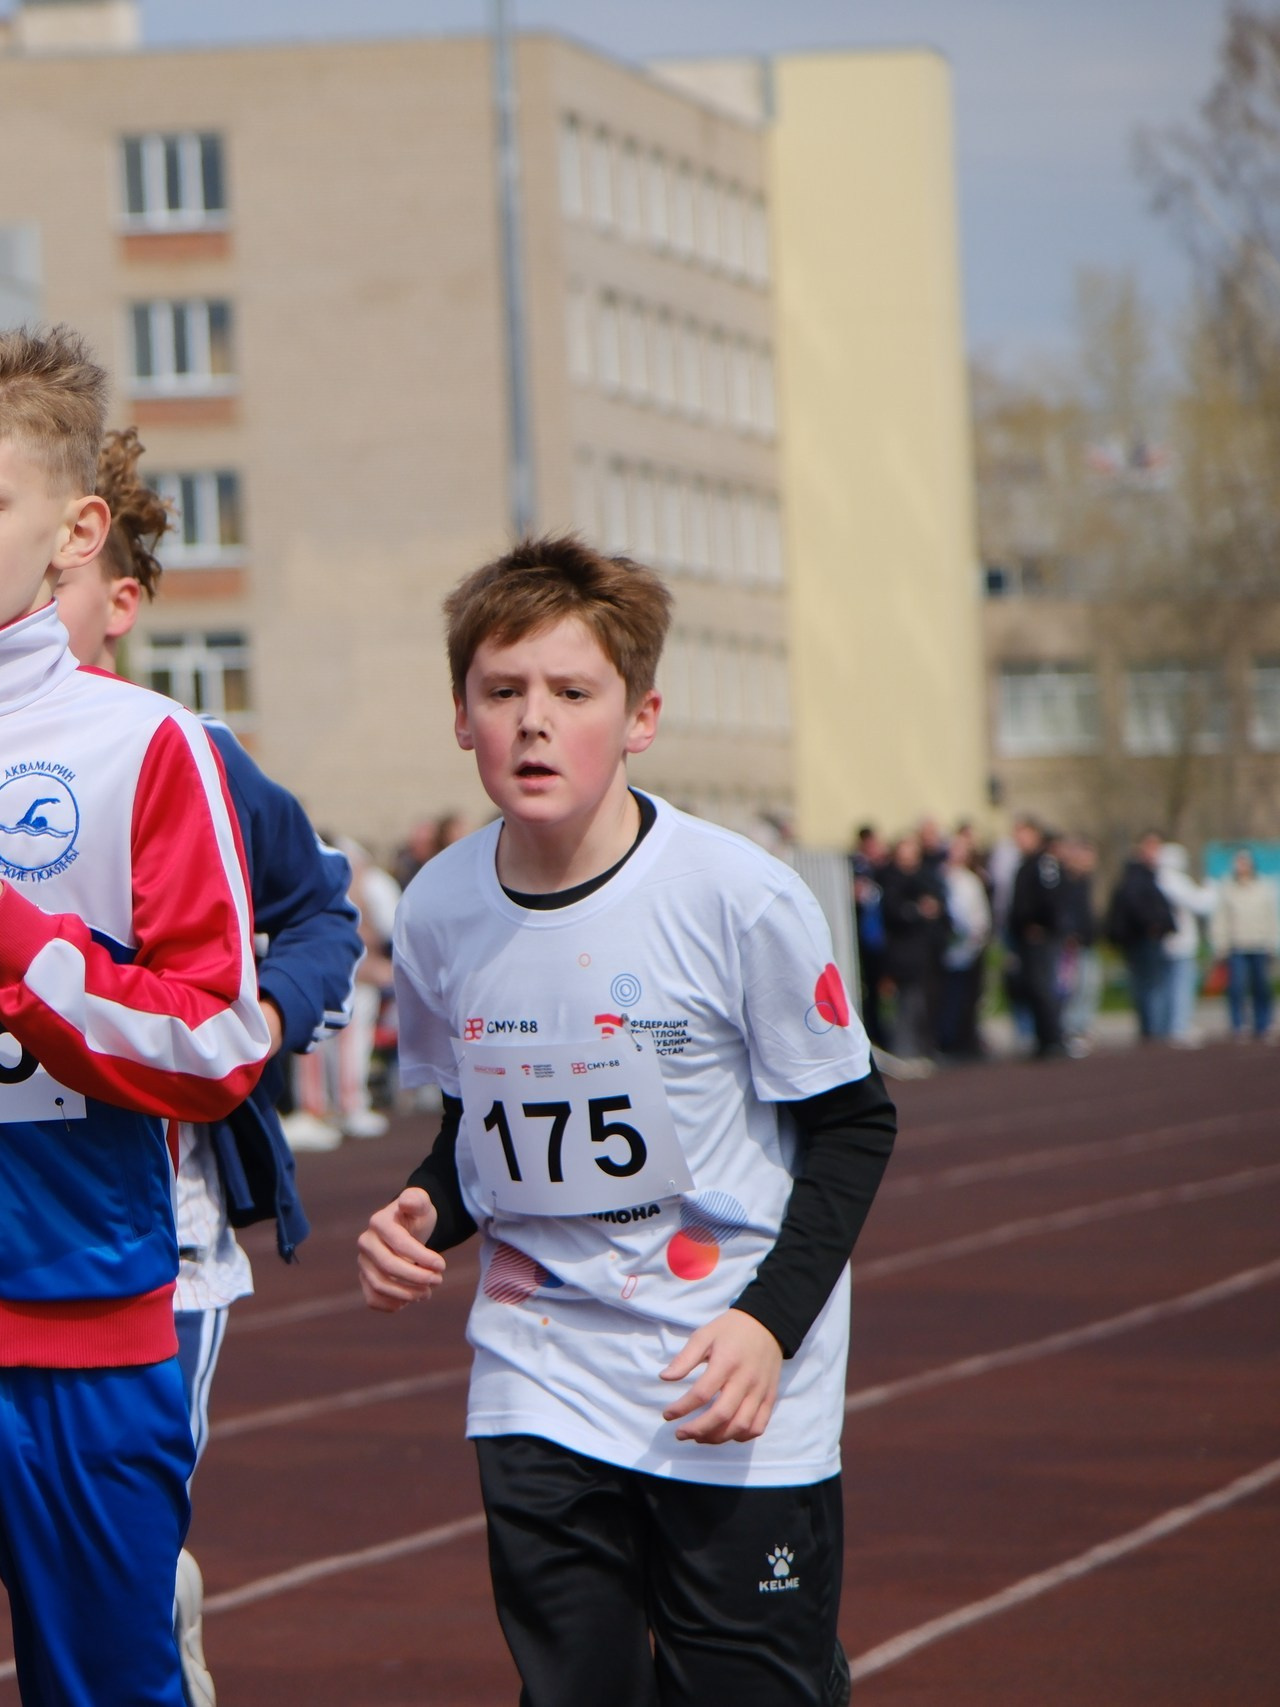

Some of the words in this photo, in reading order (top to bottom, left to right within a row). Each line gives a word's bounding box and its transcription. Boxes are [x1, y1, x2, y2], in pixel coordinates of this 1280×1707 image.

[4, 761, 76, 783] АКВАМАРИН
[31, 847, 80, 883] ПОЛЯНЫ
[630, 1019, 688, 1029] ФЕДЕРАЦИЯ
[654, 1037, 692, 1048] УБЛИКИ
[483, 1094, 648, 1183] 175
[758, 1577, 800, 1592] KELME
